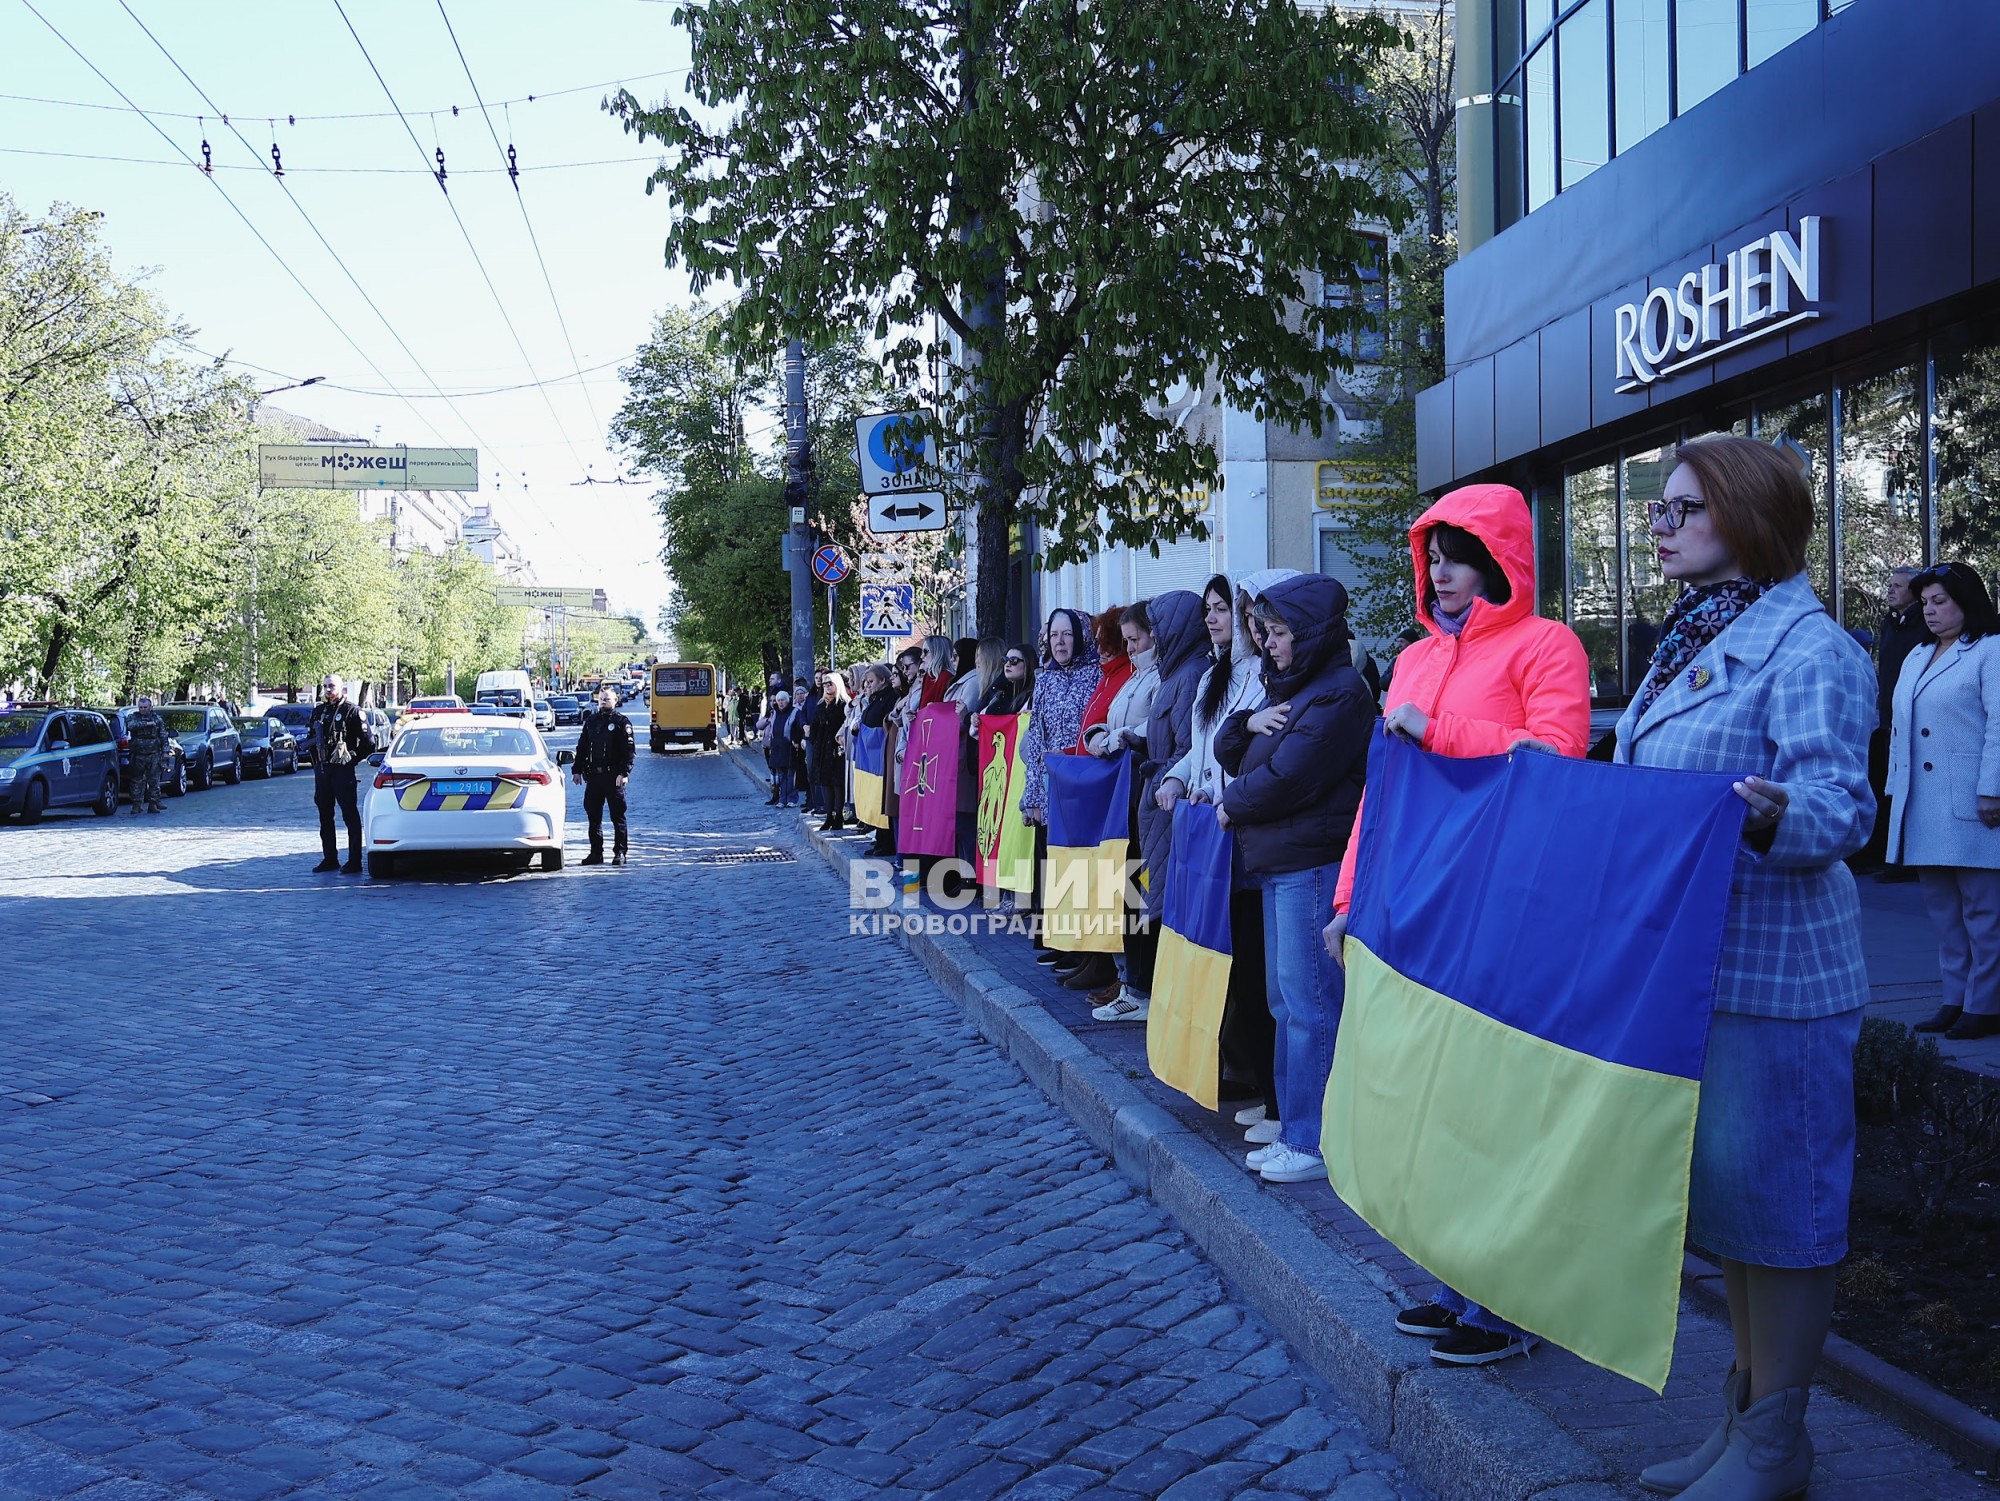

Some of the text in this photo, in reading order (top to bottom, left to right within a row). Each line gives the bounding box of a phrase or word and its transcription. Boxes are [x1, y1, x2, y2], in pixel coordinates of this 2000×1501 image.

[1615, 215, 1821, 383] ROSHEN
[880, 473, 923, 489] ЗОНА
[688, 679, 708, 688] СТО
[459, 782, 486, 792] 2916
